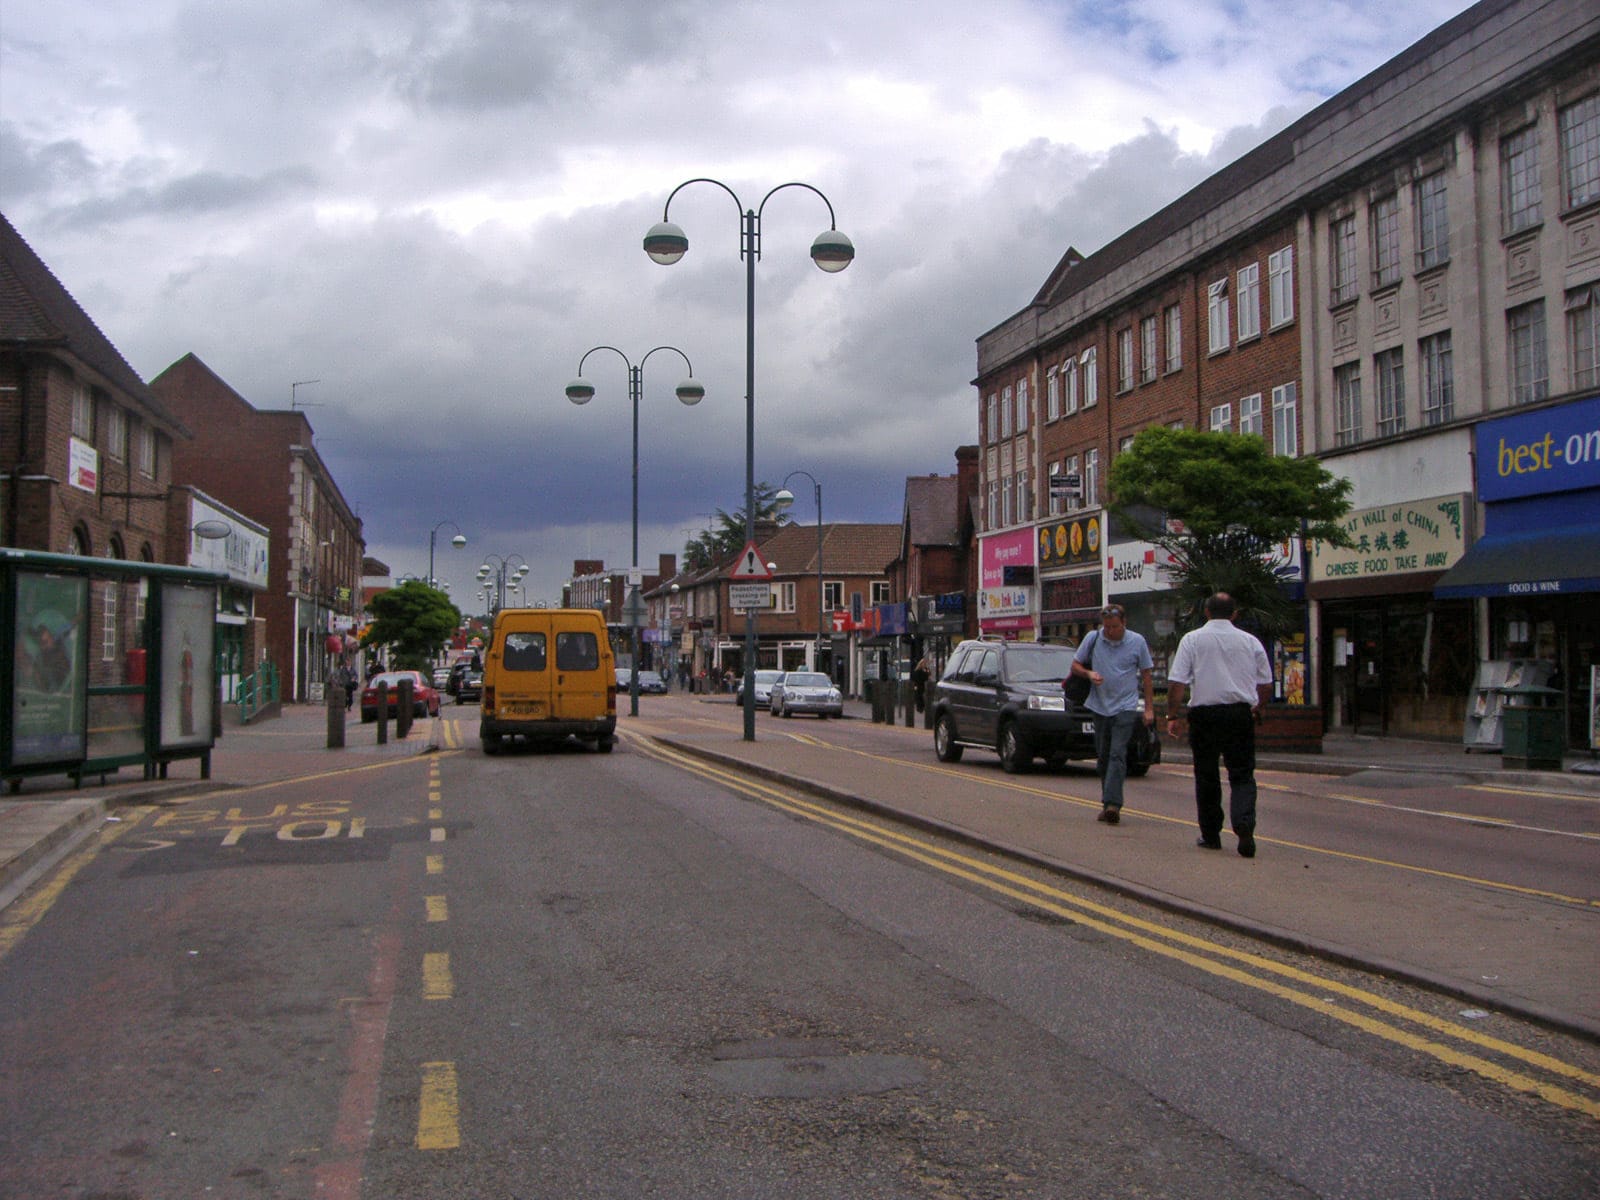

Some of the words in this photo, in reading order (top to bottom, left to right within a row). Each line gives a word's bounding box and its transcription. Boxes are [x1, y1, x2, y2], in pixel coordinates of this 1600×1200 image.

[1362, 509, 1387, 527] WALL
[1392, 508, 1402, 522] of
[1407, 510, 1439, 539] CHINA
[1326, 561, 1358, 577] CHINESE
[1364, 558, 1388, 573] FOOD
[1395, 555, 1418, 570] TAKE
[1424, 552, 1448, 567] AWAY
[1509, 583, 1531, 593] FOOD
[1532, 582, 1538, 592] &
[1540, 581, 1560, 591] WINE
[989, 593, 1001, 609] The
[1001, 592, 1011, 608] Ink
[1013, 591, 1026, 607] Lab
